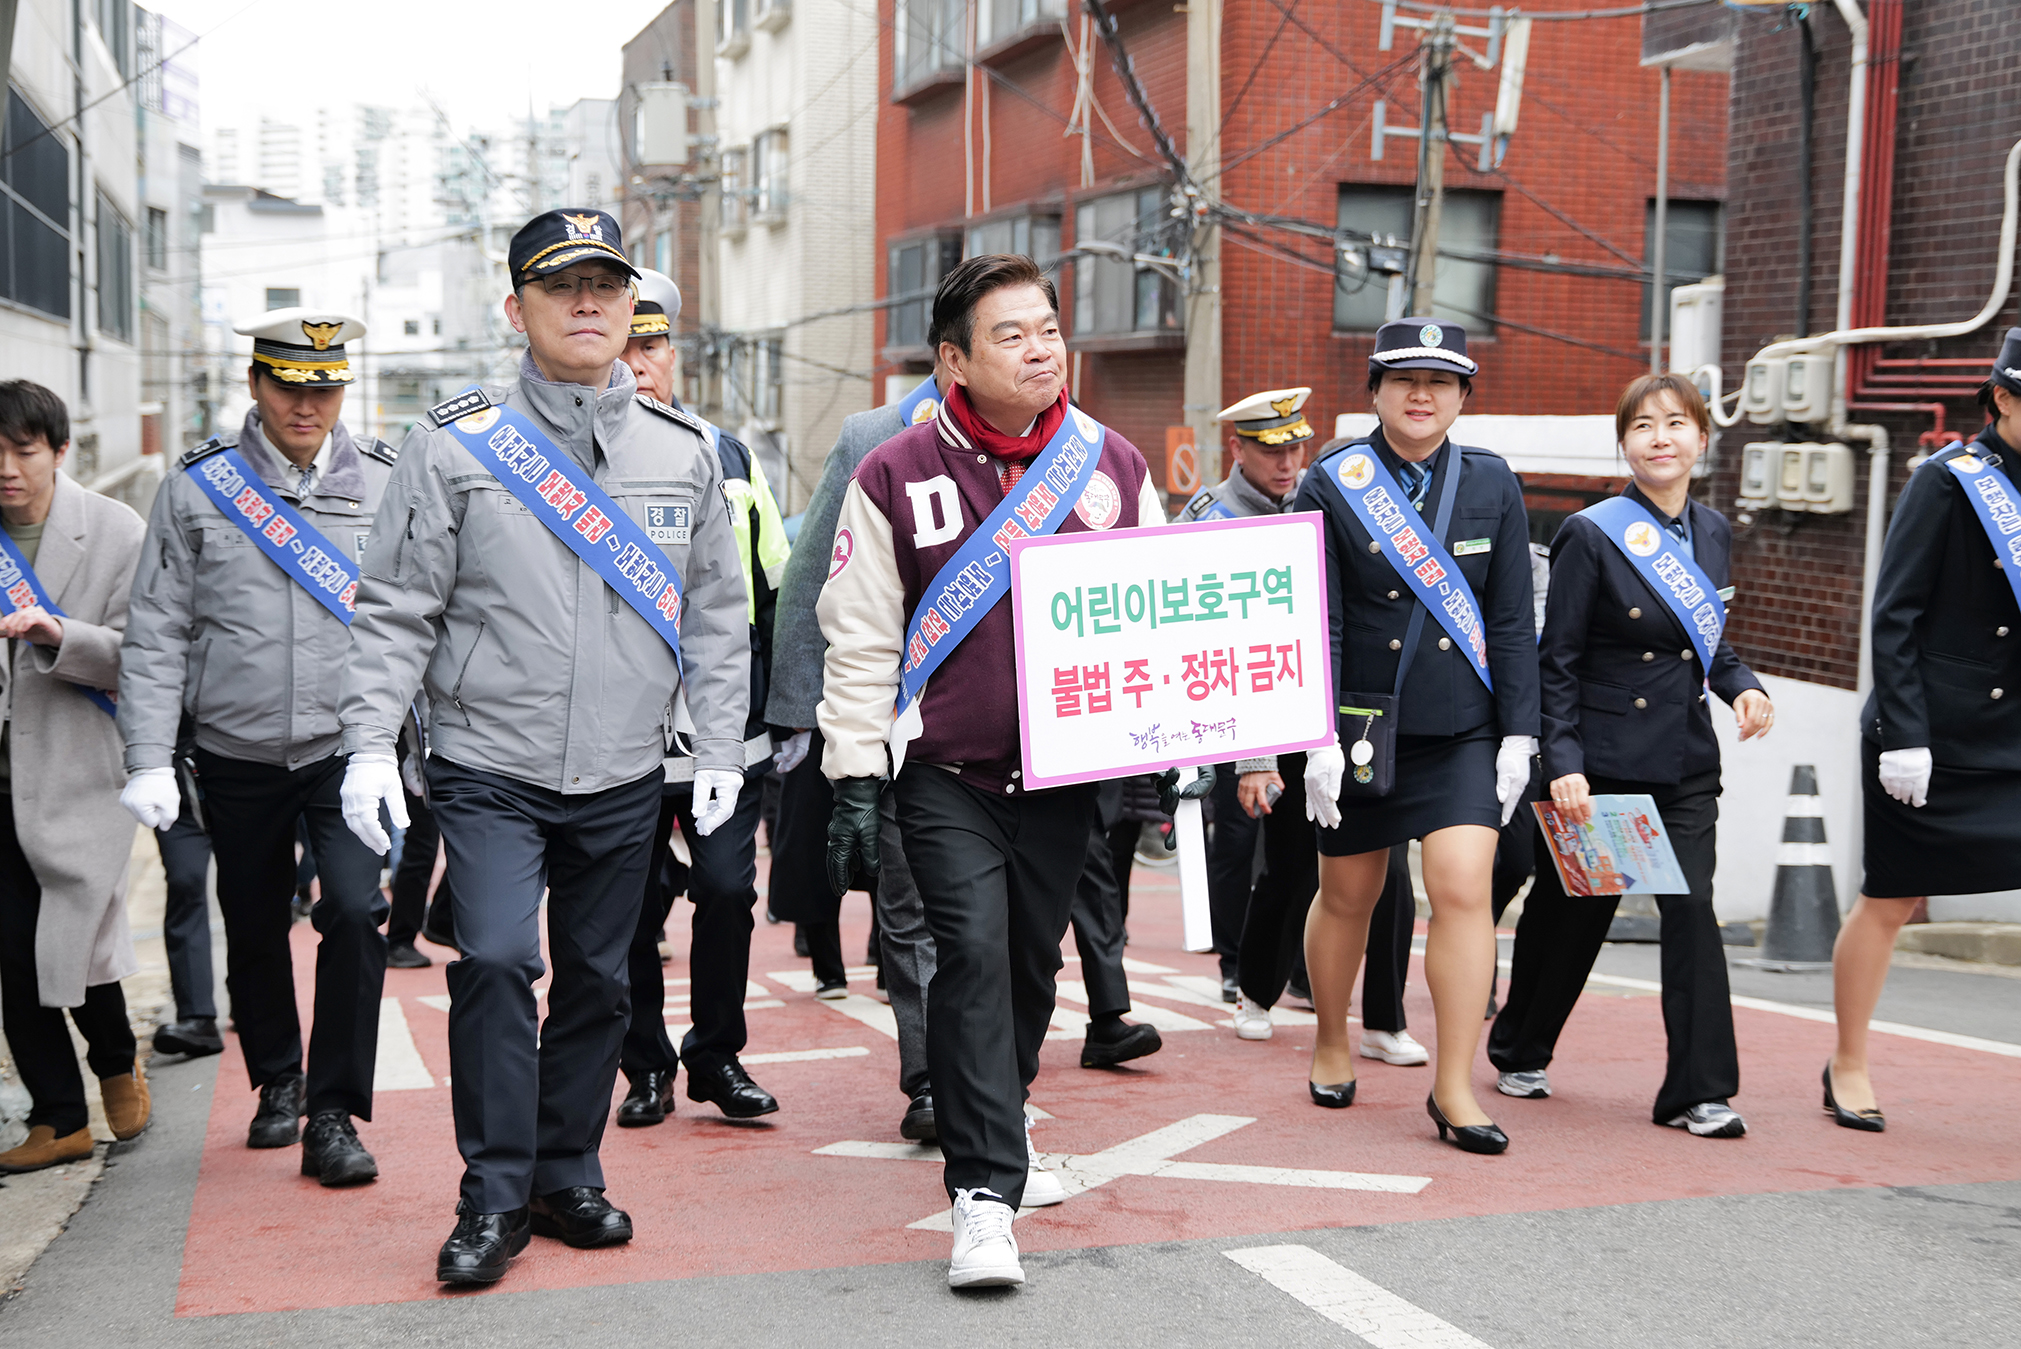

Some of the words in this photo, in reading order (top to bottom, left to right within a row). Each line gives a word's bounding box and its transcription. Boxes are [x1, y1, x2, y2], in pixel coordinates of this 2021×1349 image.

[1046, 435, 1088, 494] 운전자는
[201, 455, 246, 498] 운전자는
[233, 486, 275, 528] 보행자
[298, 546, 350, 594] 보행자는
[488, 424, 550, 484] 운전자는
[535, 469, 588, 521] 보행자
[614, 542, 666, 599] 보행자는
[650, 507, 687, 527] 경찰
[650, 530, 687, 539] POLICE
[905, 474, 964, 549] D
[1014, 480, 1060, 532] 보행자
[1974, 475, 2021, 535] 보행자는
[1362, 486, 1406, 534] 운전자는
[1390, 525, 1429, 567] 보행자
[1442, 588, 1475, 635] 보행자는
[1651, 551, 1706, 609] 보행자는
[937, 561, 994, 622] 보행자는
[1051, 565, 1293, 637] 어린이보호구역
[921, 607, 950, 647] 안전
[1051, 661, 1112, 718] 불법
[1247, 639, 1303, 693] 금지
[1129, 723, 1171, 753] 행복을
[1170, 731, 1191, 742] 여는
[1190, 717, 1237, 744] 동대문구
